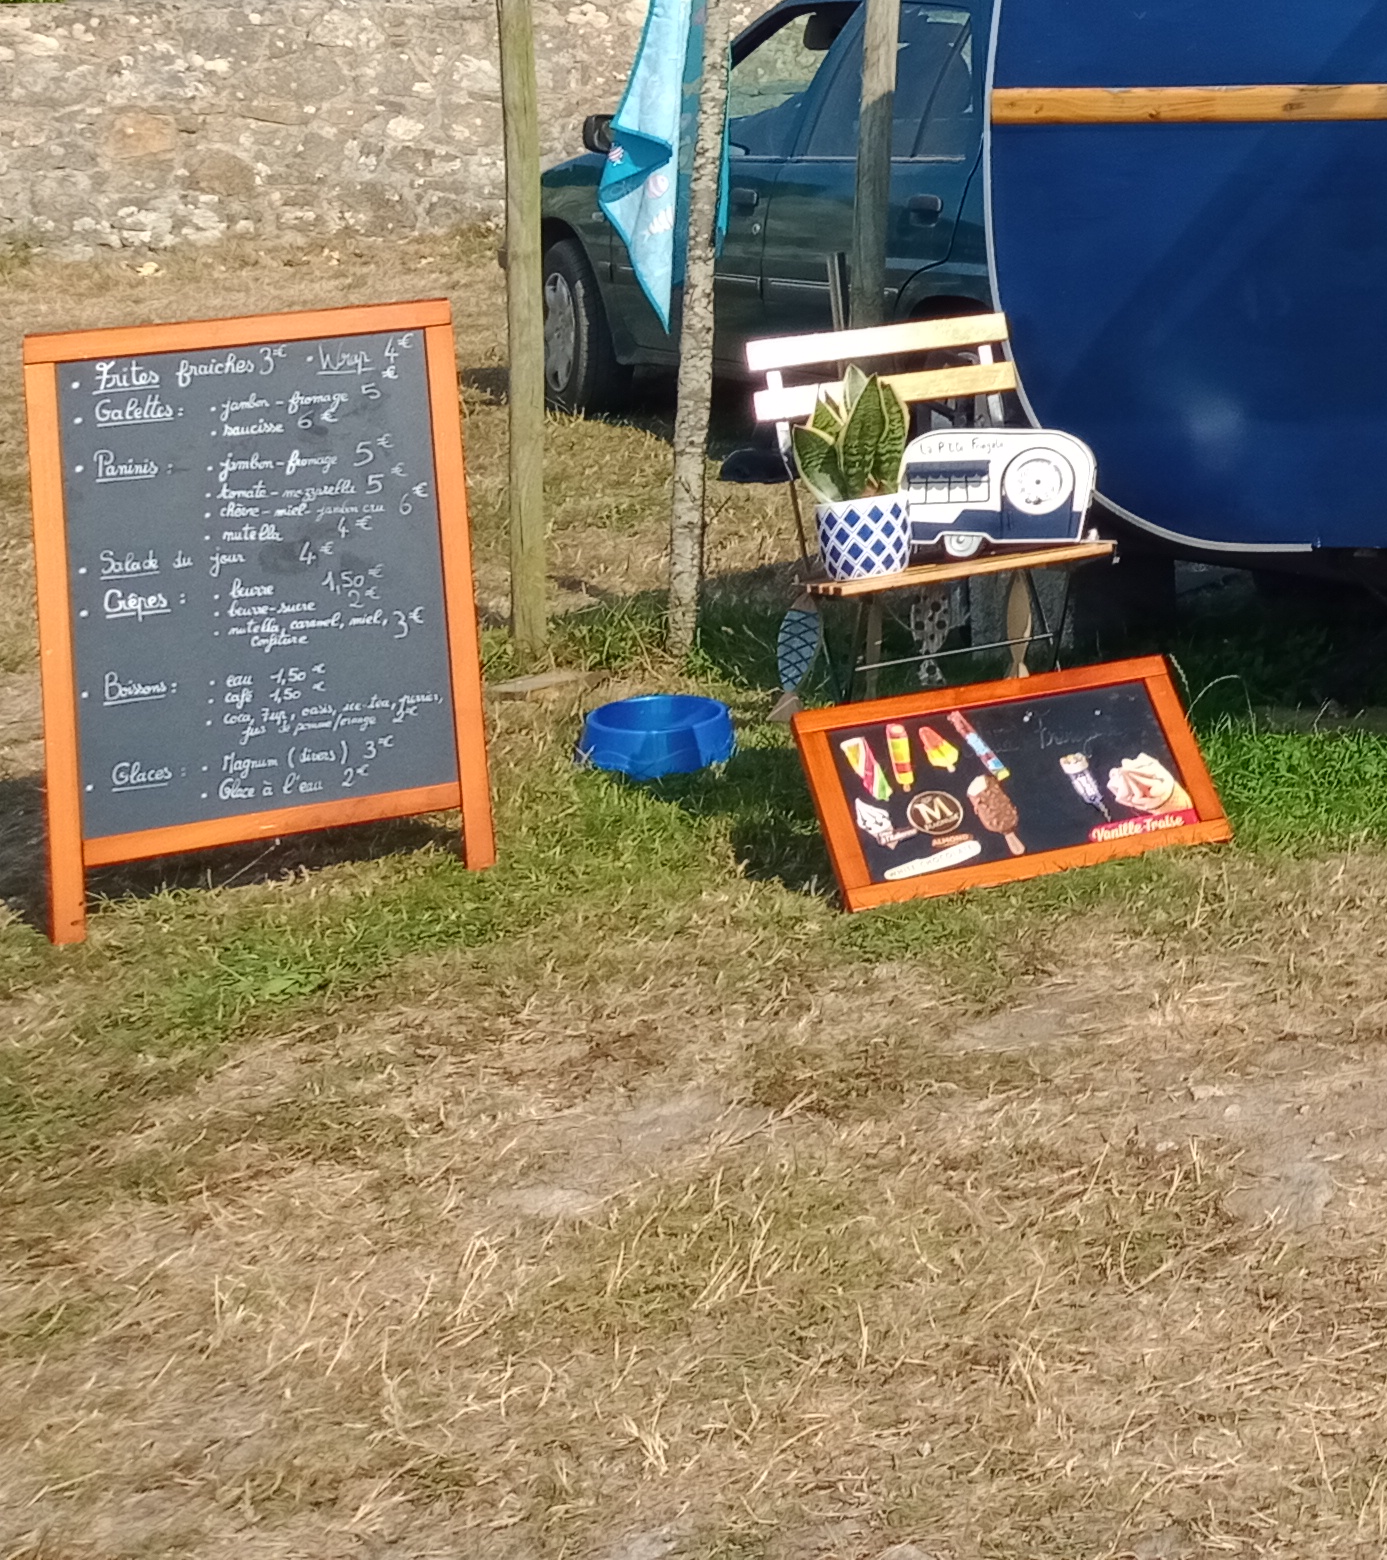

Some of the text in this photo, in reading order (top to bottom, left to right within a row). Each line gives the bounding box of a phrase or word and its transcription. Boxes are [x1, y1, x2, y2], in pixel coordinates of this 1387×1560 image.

[318, 342, 372, 374] Wrap
[95, 360, 160, 390] Frites
[222, 418, 285, 436] saucisse
[93, 449, 159, 477] Paninis
[222, 524, 284, 541] nutella
[99, 550, 160, 574] Salade
[172, 550, 194, 568] du
[209, 546, 246, 577] jour
[103, 589, 169, 622] Crêpes
[229, 578, 274, 599] beurre
[226, 674, 253, 687] eau
[112, 761, 173, 785] Glaces
[222, 752, 279, 779] Magnum
[218, 778, 256, 800] Glace
[262, 780, 274, 796] à
